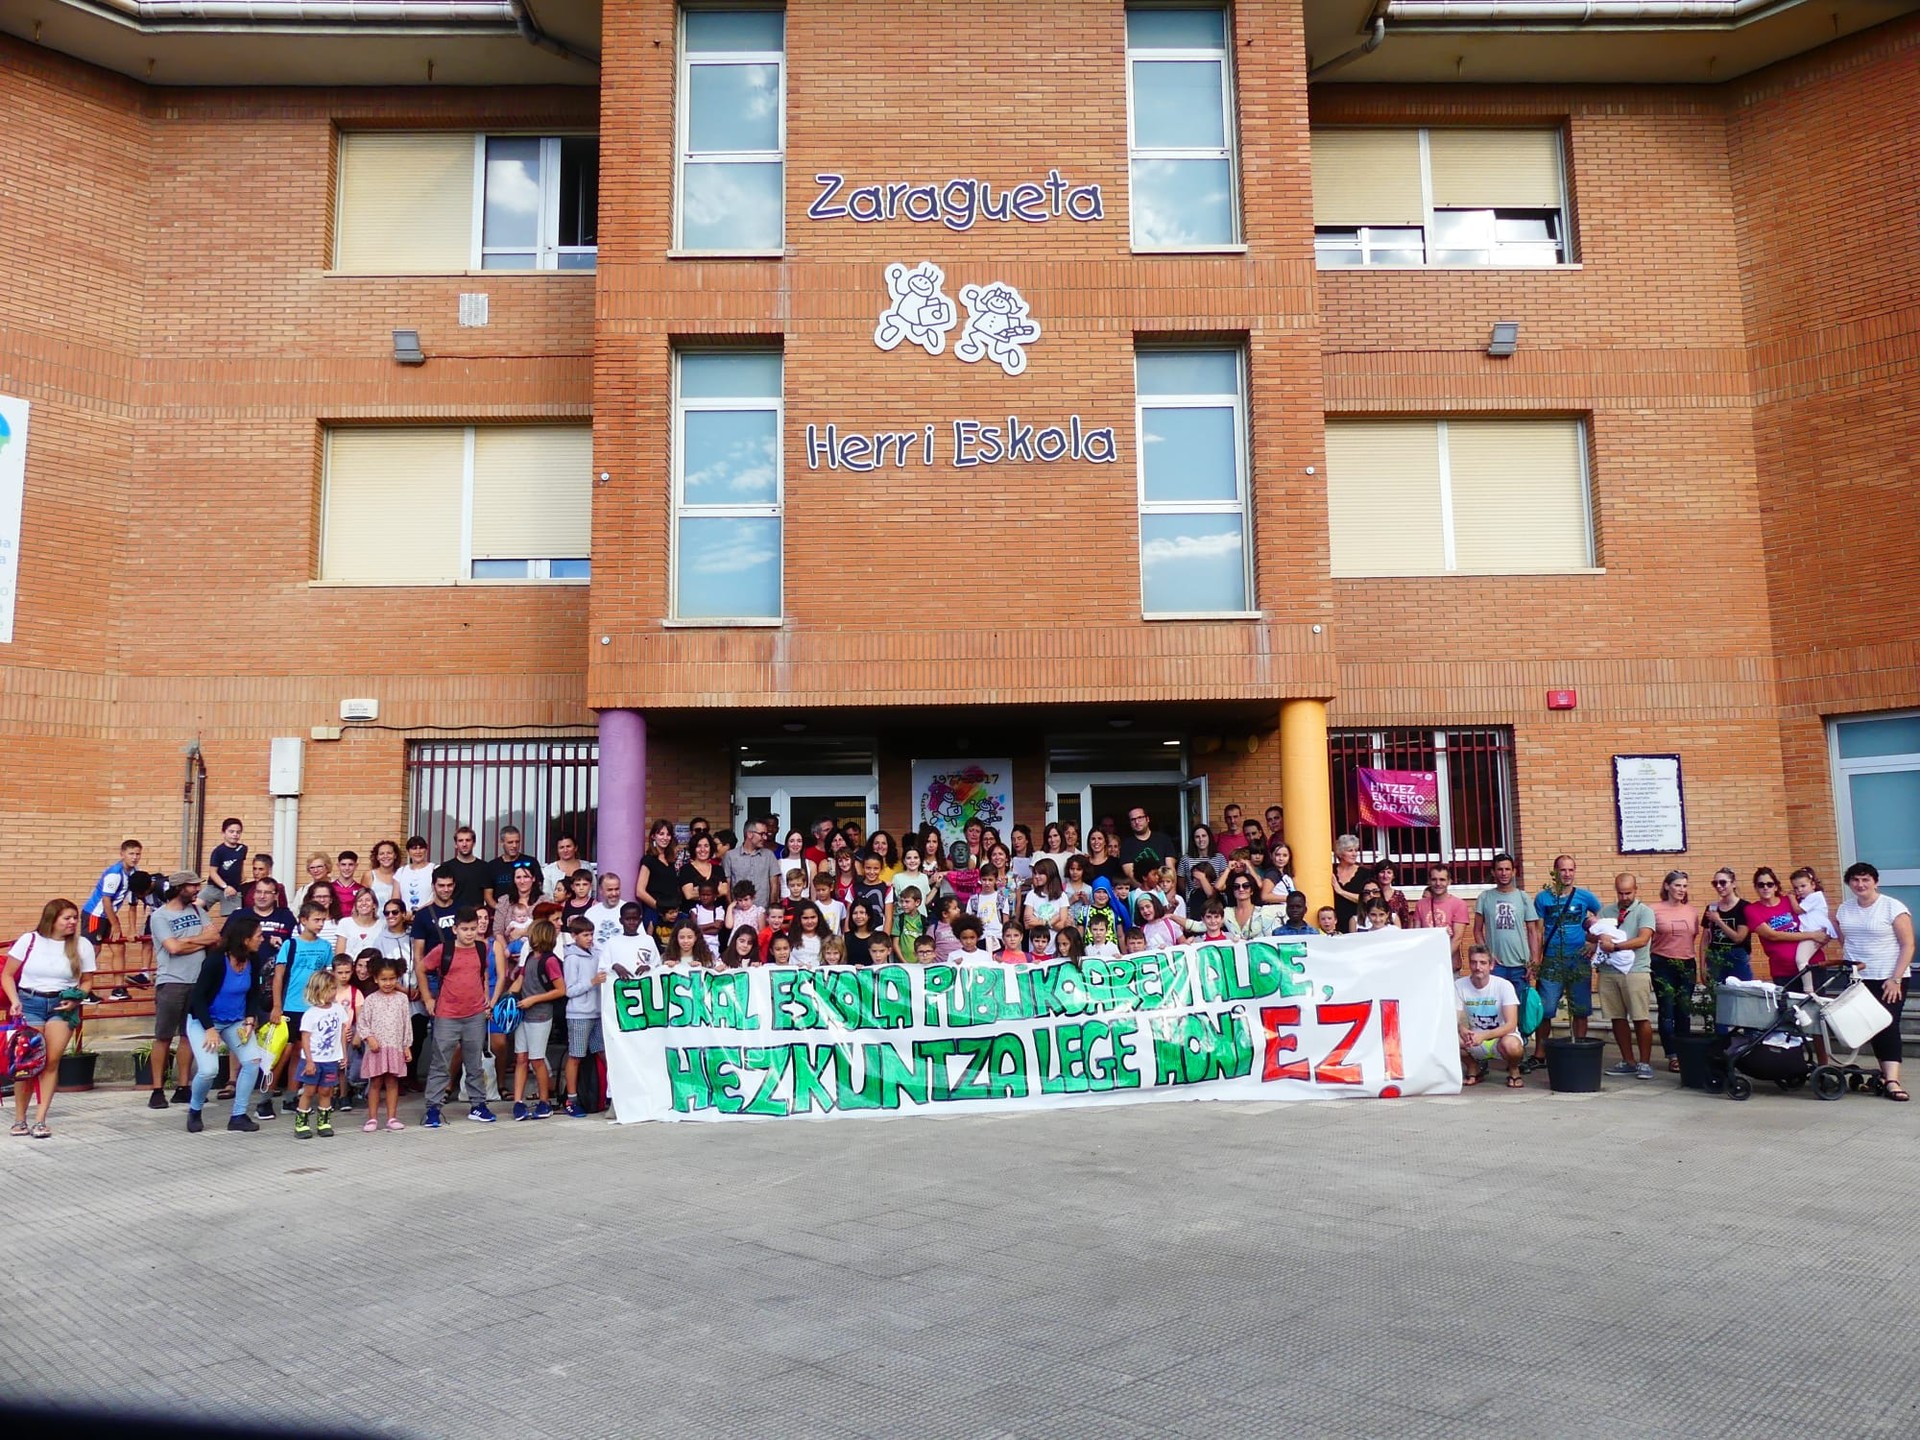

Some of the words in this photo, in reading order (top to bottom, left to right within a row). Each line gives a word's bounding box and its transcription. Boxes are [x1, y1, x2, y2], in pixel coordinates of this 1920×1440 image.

[807, 169, 1104, 231] Zaragueta
[806, 423, 934, 471] Herri
[953, 414, 1118, 468] Eskola
[1370, 781, 1416, 795] HITZEZ
[1371, 791, 1426, 805] EKITEKO
[1372, 802, 1422, 816] GARAIA
[614, 970, 761, 1032] EUSKAL
[770, 965, 913, 1031] ESKOLA
[1196, 941, 1335, 1003] ALDE,
[665, 1032, 1029, 1117] HEZKUNTZA
[1032, 1020, 1141, 1096] LEGE
[1260, 999, 1405, 1099] EZ!
